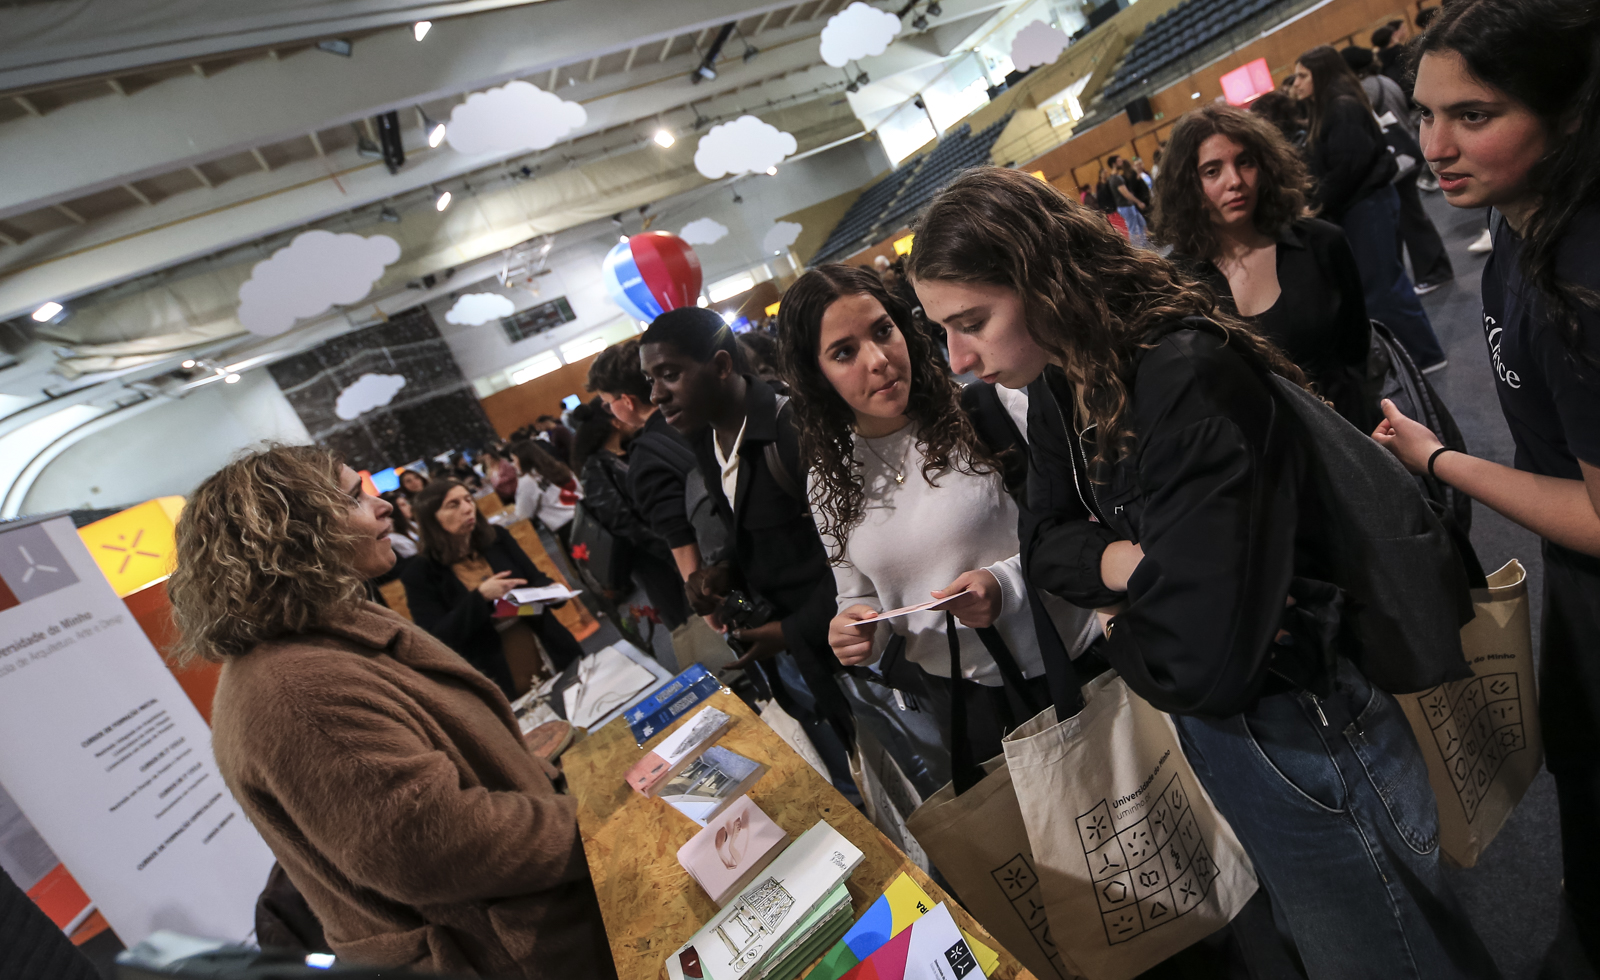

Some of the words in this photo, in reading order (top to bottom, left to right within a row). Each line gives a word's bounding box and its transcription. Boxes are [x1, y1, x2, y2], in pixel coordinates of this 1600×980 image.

[60, 611, 93, 629] Minho
[1487, 653, 1516, 661] Minho
[1112, 773, 1154, 809] Universidade
[1153, 765, 1160, 776] do
[1159, 749, 1171, 768] Minho
